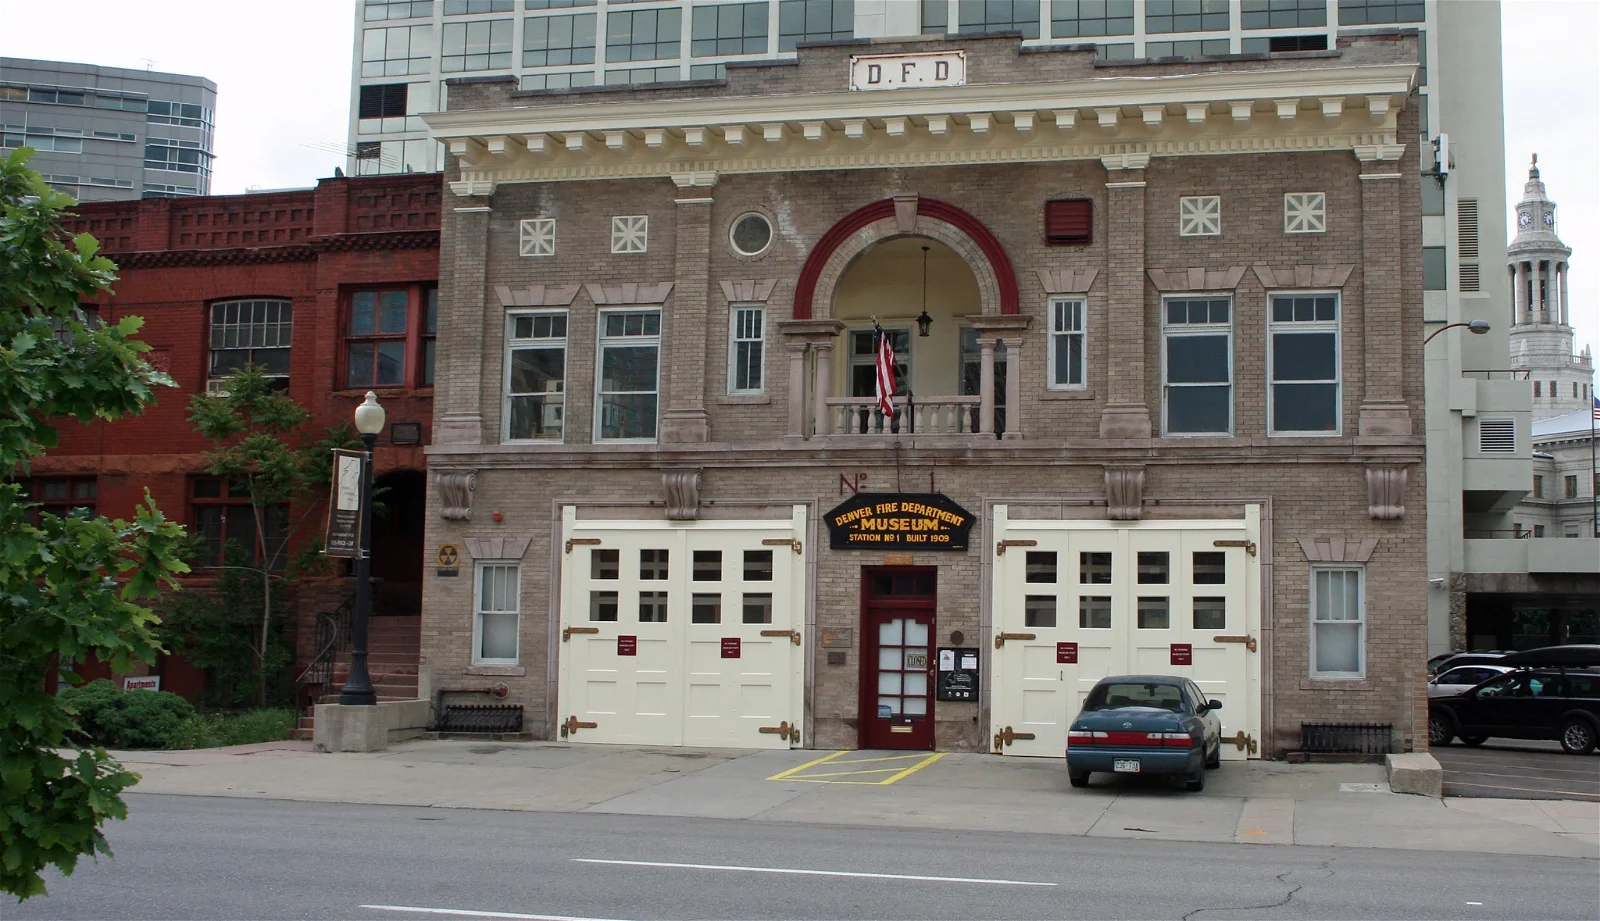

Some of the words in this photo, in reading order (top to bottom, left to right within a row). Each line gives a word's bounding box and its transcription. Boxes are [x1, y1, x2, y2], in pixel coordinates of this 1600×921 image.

[929, 471, 935, 493] 1
[835, 506, 873, 527] DENVER
[876, 502, 898, 514] FIRE
[901, 502, 965, 527] DEPARTMENT
[860, 518, 939, 531] MUSEUM
[849, 534, 881, 542] STATION
[906, 534, 928, 542] BUILT
[930, 534, 950, 542] 1909
[127, 680, 156, 689] Apartments
